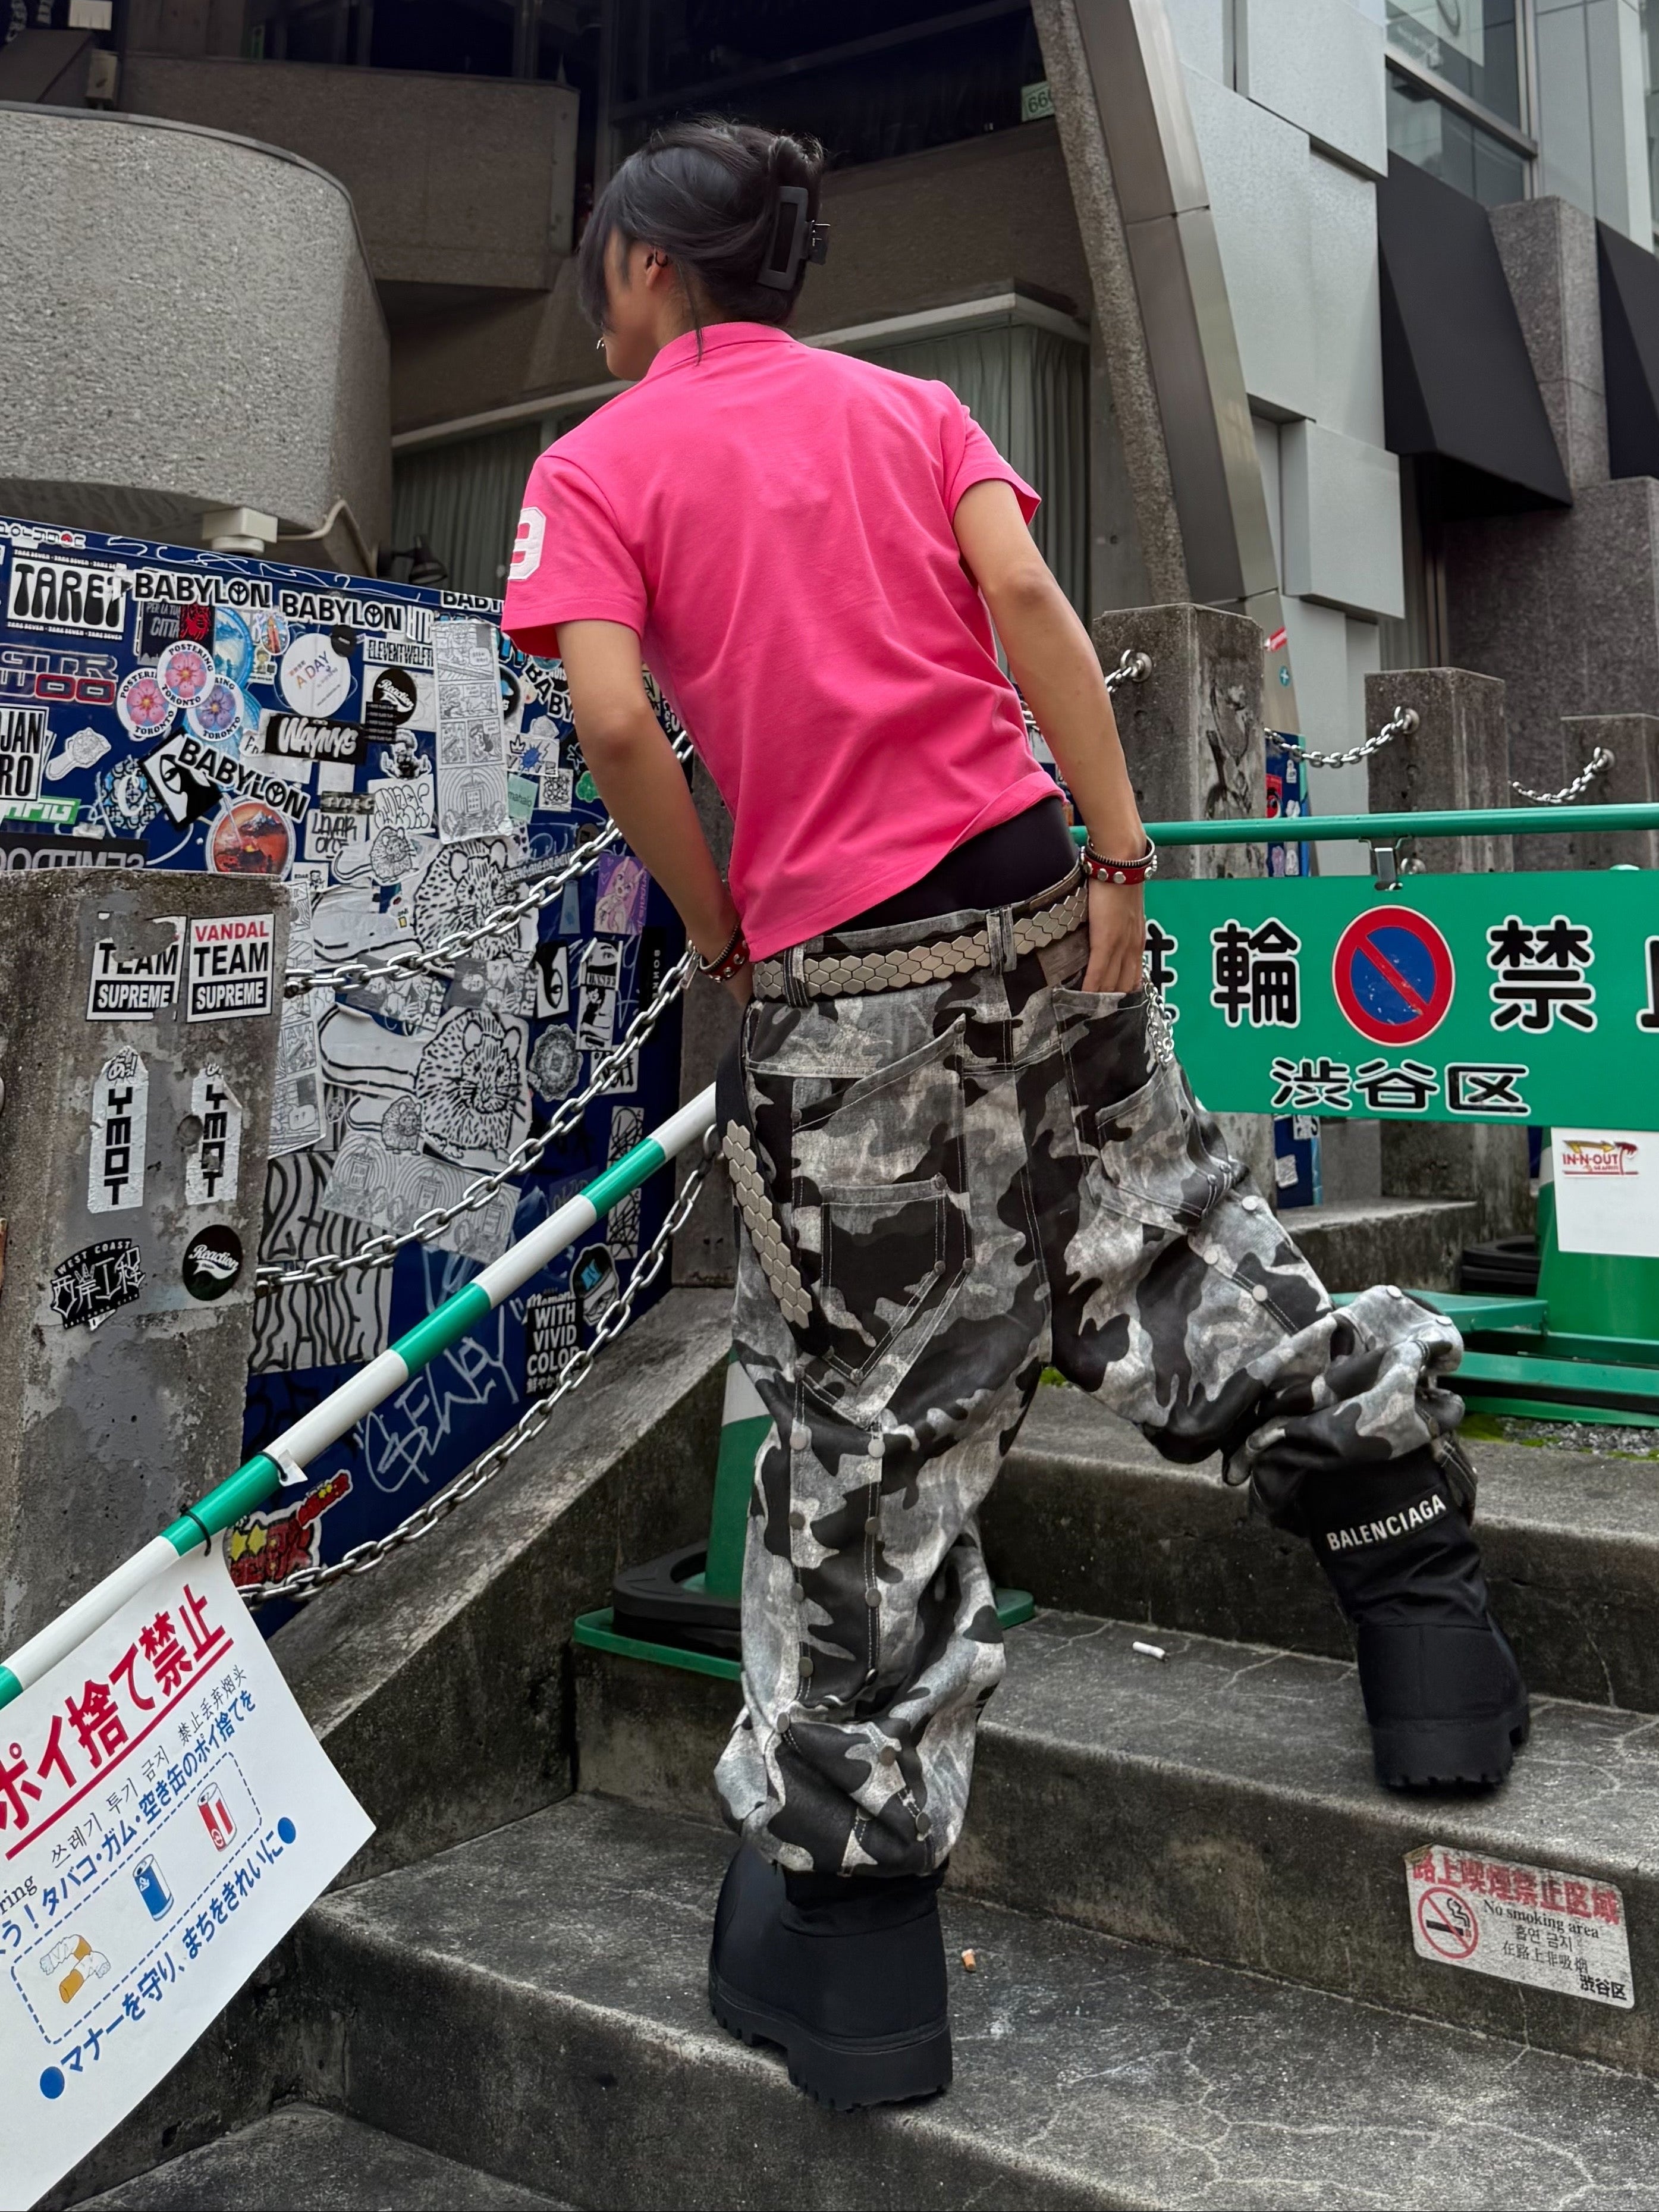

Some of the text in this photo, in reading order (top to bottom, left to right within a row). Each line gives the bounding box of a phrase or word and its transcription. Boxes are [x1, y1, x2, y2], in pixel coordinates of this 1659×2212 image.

[135, 573, 271, 607] BABYLON
[282, 592, 403, 632] BABYLON
[169, 643, 214, 672] POSTERING
[120, 671, 158, 699] POSTERI
[162, 685, 202, 706] TORONTO
[135, 710, 174, 735] TORONTO
[203, 716, 241, 739] TORONTO
[178, 736, 309, 820] BABYLON
[195, 921, 269, 942] VANDAL
[194, 942, 269, 977] TEAM
[98, 983, 170, 1009] SUPREME
[197, 981, 264, 1010] SUPREME
[1270, 1057, 1531, 1116] 渋谷区
[1562, 1154, 1619, 1165] IN-N-OUT
[58, 1241, 131, 1275] WEST COAST
[188, 1244, 240, 1271] Reaction
[535, 1301, 576, 1330] WITH
[533, 1324, 577, 1353] VIVID
[1326, 1494, 1447, 1551] BALENCIAGA
[0, 1583, 226, 1831] ポイ捨て禁止
[51, 1745, 170, 1869] 쓰레기 투기 금지
[1483, 1899, 1600, 1939] No smoking area
[1546, 1932, 1573, 1952] 금지
[1579, 1973, 1627, 2001] 渋谷区
